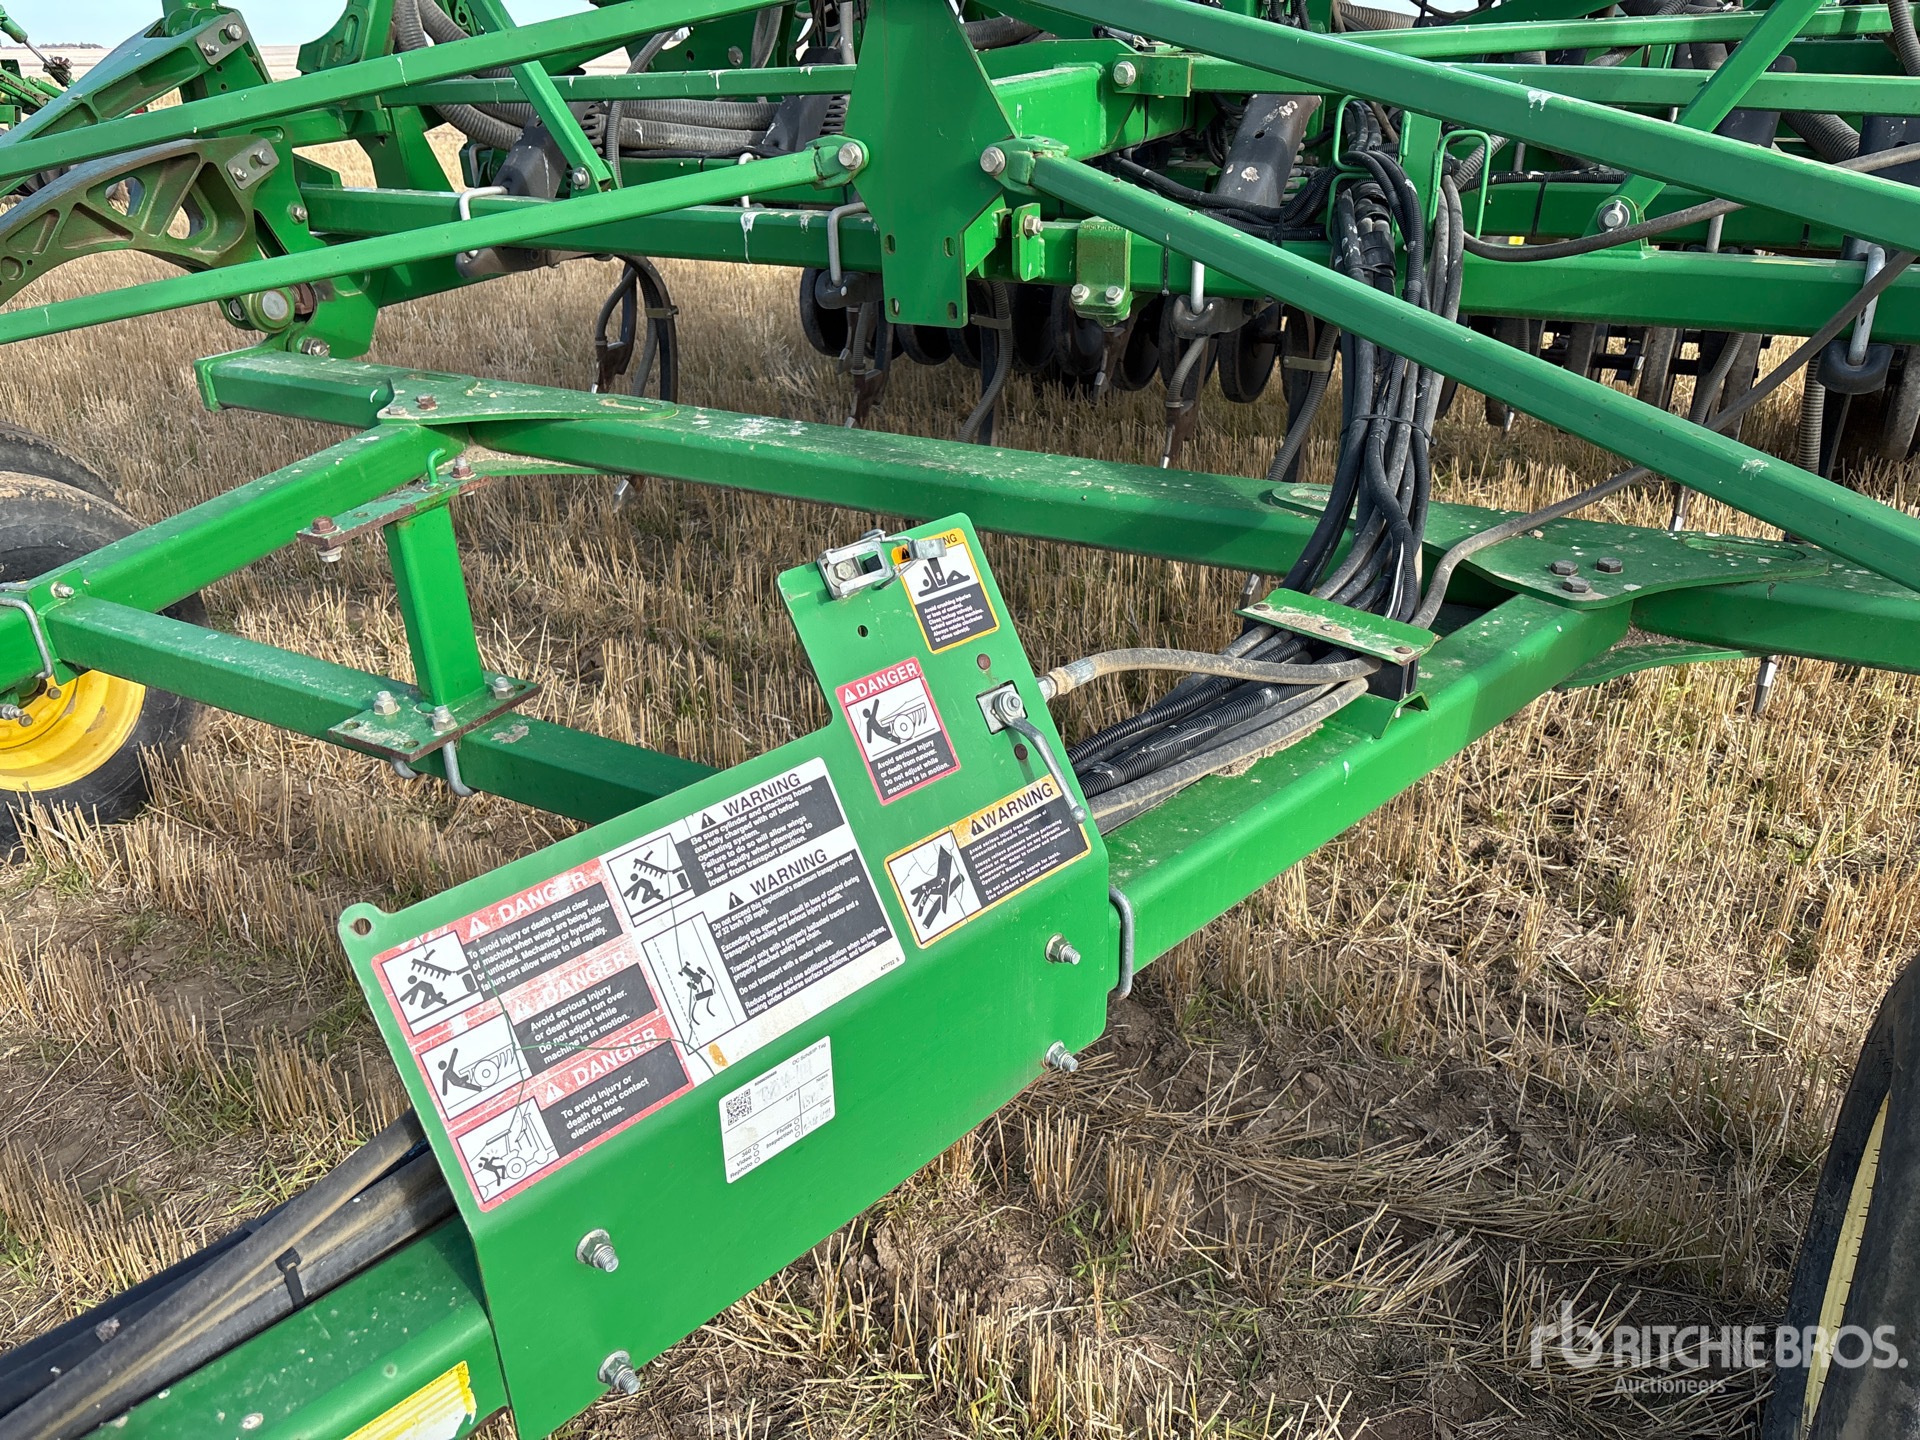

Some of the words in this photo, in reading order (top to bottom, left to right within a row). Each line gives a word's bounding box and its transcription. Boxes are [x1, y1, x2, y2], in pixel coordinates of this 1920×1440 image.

[856, 663, 918, 697] DANGER
[878, 757, 895, 770] Avoid
[895, 748, 917, 761] serious
[917, 740, 934, 751] injury
[887, 764, 903, 775] death
[902, 758, 916, 768] from
[893, 773, 904, 782] not
[904, 764, 923, 777] adjust
[923, 758, 938, 768] while
[723, 773, 801, 816] WARNING
[887, 779, 913, 795] machine
[928, 763, 950, 775] motion.
[690, 836, 702, 845] Be
[703, 829, 719, 840] sure
[720, 815, 747, 832] cylinder
[748, 807, 762, 819] and
[762, 794, 793, 812] attaching
[792, 785, 812, 798] hoses
[694, 844, 707, 853] are
[707, 836, 723, 847] fully
[724, 821, 753, 839] charged
[753, 815, 768, 825] with
[768, 809, 778, 818] oil
[777, 801, 799, 814] before
[981, 783, 1053, 828] WARNING
[698, 842, 733, 861] operating
[733, 830, 760, 845] system.
[701, 854, 727, 870] Failure
[736, 845, 746, 853] do
[756, 833, 768, 843] will
[769, 825, 786, 837] allow
[787, 816, 807, 828] wings
[708, 873, 728, 887] lower
[729, 865, 747, 877] from
[746, 848, 778, 868] transport
[778, 836, 807, 854] position.
[714, 863, 726, 874] fall
[726, 852, 750, 868] rapidly
[751, 843, 770, 856] when
[770, 826, 806, 847] attempting
[750, 849, 827, 895] WARNING
[498, 870, 588, 922] DANGER
[467, 950, 478, 959] To
[479, 939, 500, 955] avoid
[499, 931, 521, 945] injury
[521, 926, 530, 935] or
[531, 916, 551, 930] death
[551, 906, 571, 921] stand
[572, 899, 588, 911] clear
[473, 960, 481, 970] of
[482, 947, 513, 966] machine
[513, 938, 533, 951] when
[533, 927, 555, 941] wings
[555, 921, 567, 931] are
[567, 912, 588, 925] being
[587, 900, 610, 915] folded
[477, 972, 485, 981] or
[488, 955, 521, 976] unfolded.
[521, 935, 561, 959] Mechanical
[561, 932, 569, 940] or
[569, 917, 602, 936] hydraulic
[506, 969, 520, 979] can
[520, 959, 539, 973] allow
[540, 949, 561, 963] wings
[570, 937, 582, 948] fall
[582, 927, 607, 942] rapidly.
[541, 950, 629, 1006] DANGER
[531, 1013, 555, 1034] Avoid
[556, 998, 587, 1018] serious
[587, 985, 611, 1001] injury
[535, 1032, 544, 1041] or
[546, 1019, 570, 1035] death
[570, 1009, 590, 1023] from
[591, 1001, 606, 1012] run
[607, 990, 627, 1004] over.
[537, 1041, 552, 1053] Do
[553, 1032, 568, 1047] not
[568, 1018, 595, 1036] adjust
[595, 1007, 617, 1022] while
[579, 1035, 589, 1043] is
[589, 1030, 598, 1038] in
[599, 1014, 630, 1033] motion.
[572, 1026, 658, 1087] DANGER
[561, 1109, 573, 1118] To
[574, 1094, 597, 1112] avoid
[597, 1081, 621, 1099] injury
[623, 1075, 631, 1084] or
[566, 1112, 590, 1129] death
[591, 1105, 603, 1115] do
[603, 1095, 618, 1108] not
[619, 1077, 649, 1099] contact
[571, 1118, 602, 1139] electric
[602, 1106, 625, 1121] lines.
[766, 1129, 793, 1148] Inspection
[776, 1123, 792, 1135] Fluids
[730, 1162, 753, 1178] Rephoto
[737, 1155, 752, 1166] Video
[742, 1148, 751, 1157] 360
